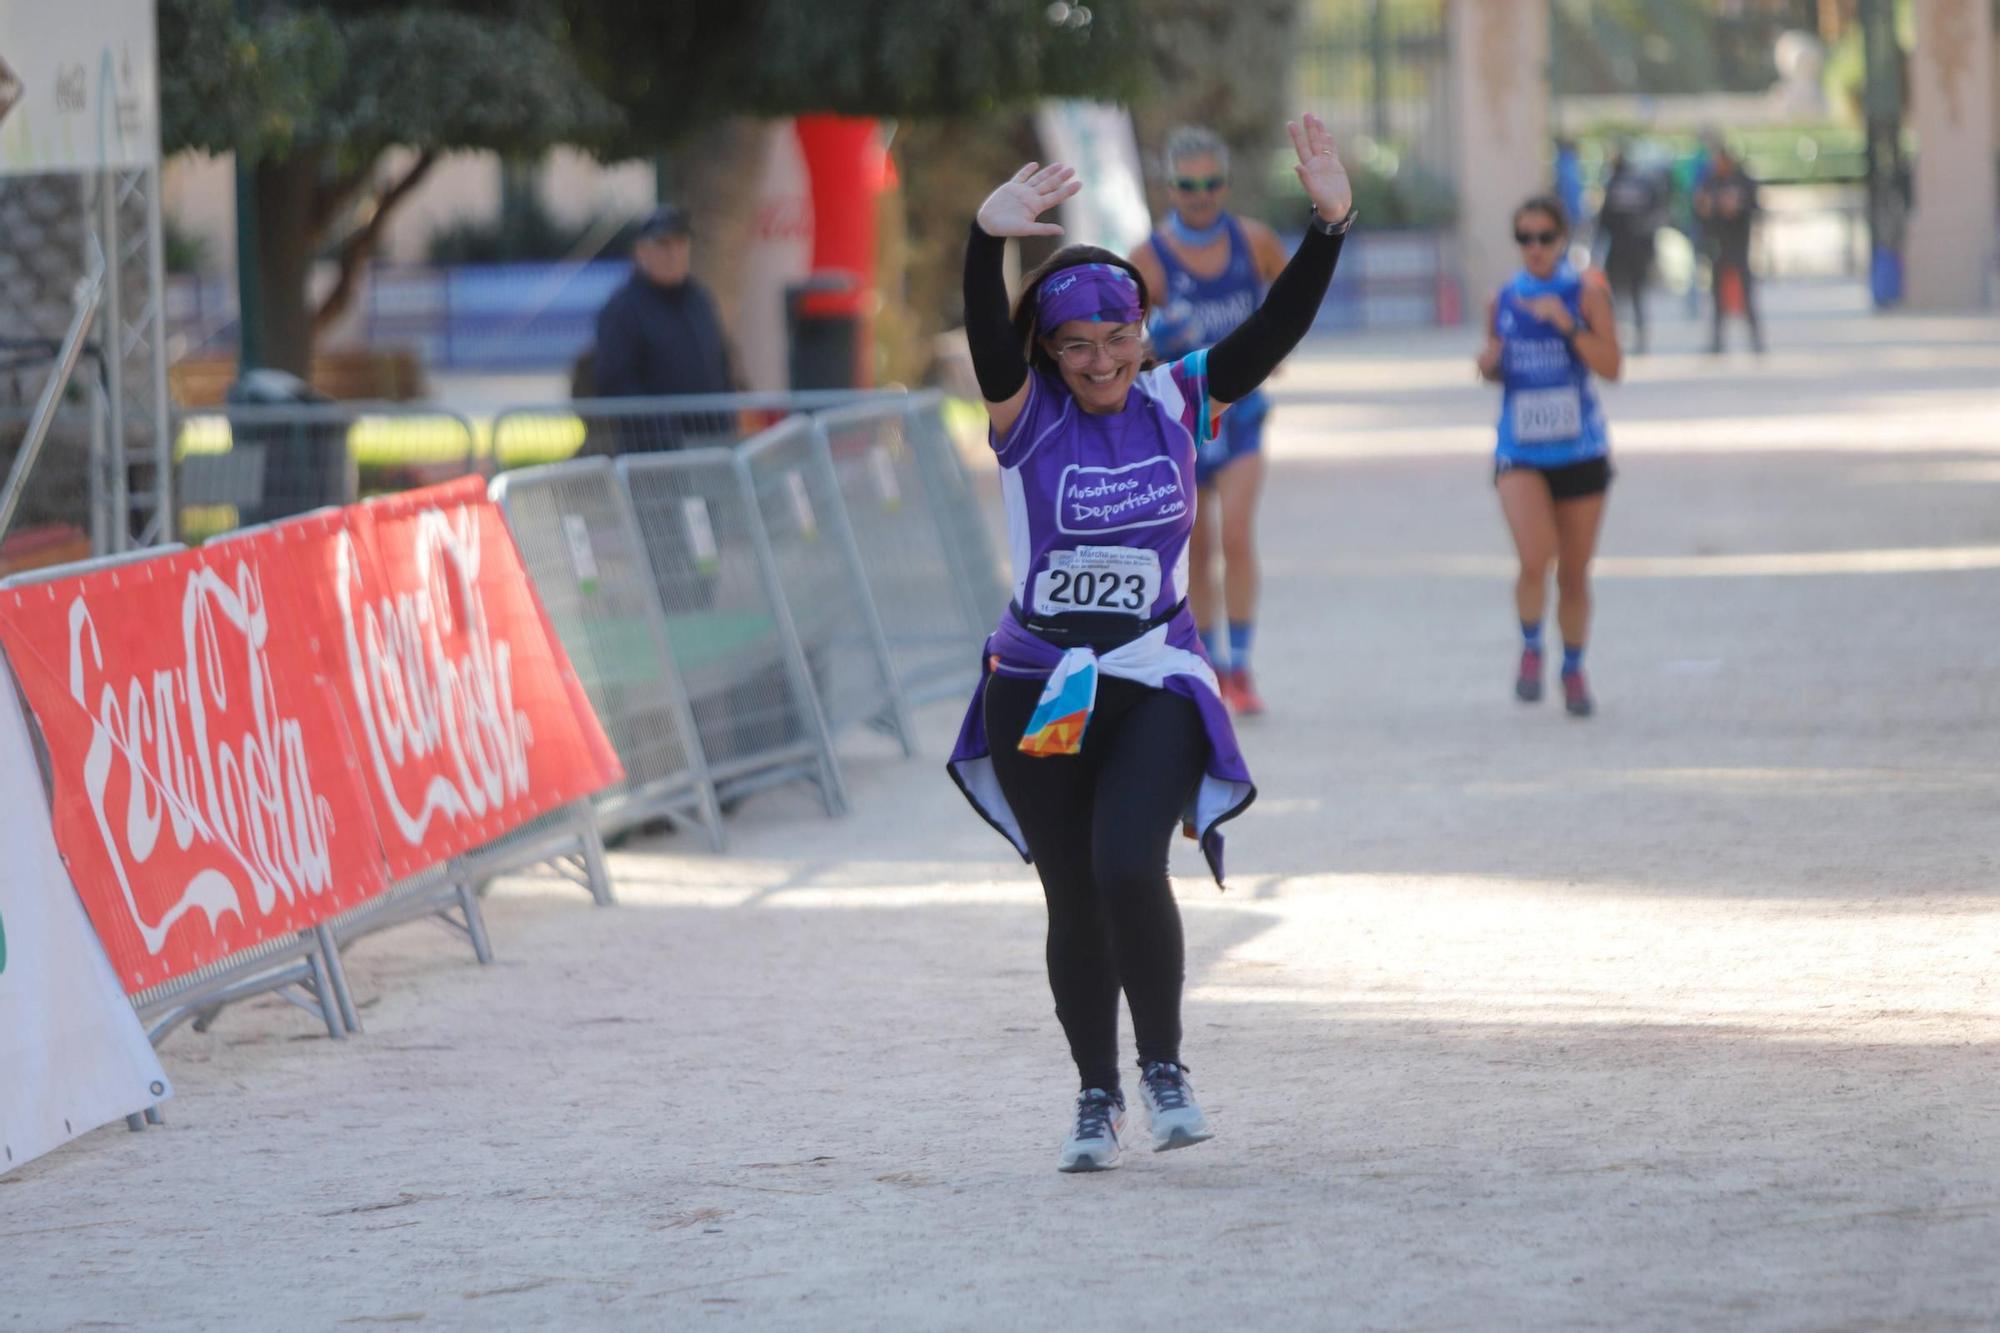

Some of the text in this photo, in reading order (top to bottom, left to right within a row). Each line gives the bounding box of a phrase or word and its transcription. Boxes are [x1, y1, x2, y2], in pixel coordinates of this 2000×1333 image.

[1072, 483, 1177, 522] Deportistas
[1158, 500, 1184, 515] .com
[1049, 569, 1146, 610] 2023
